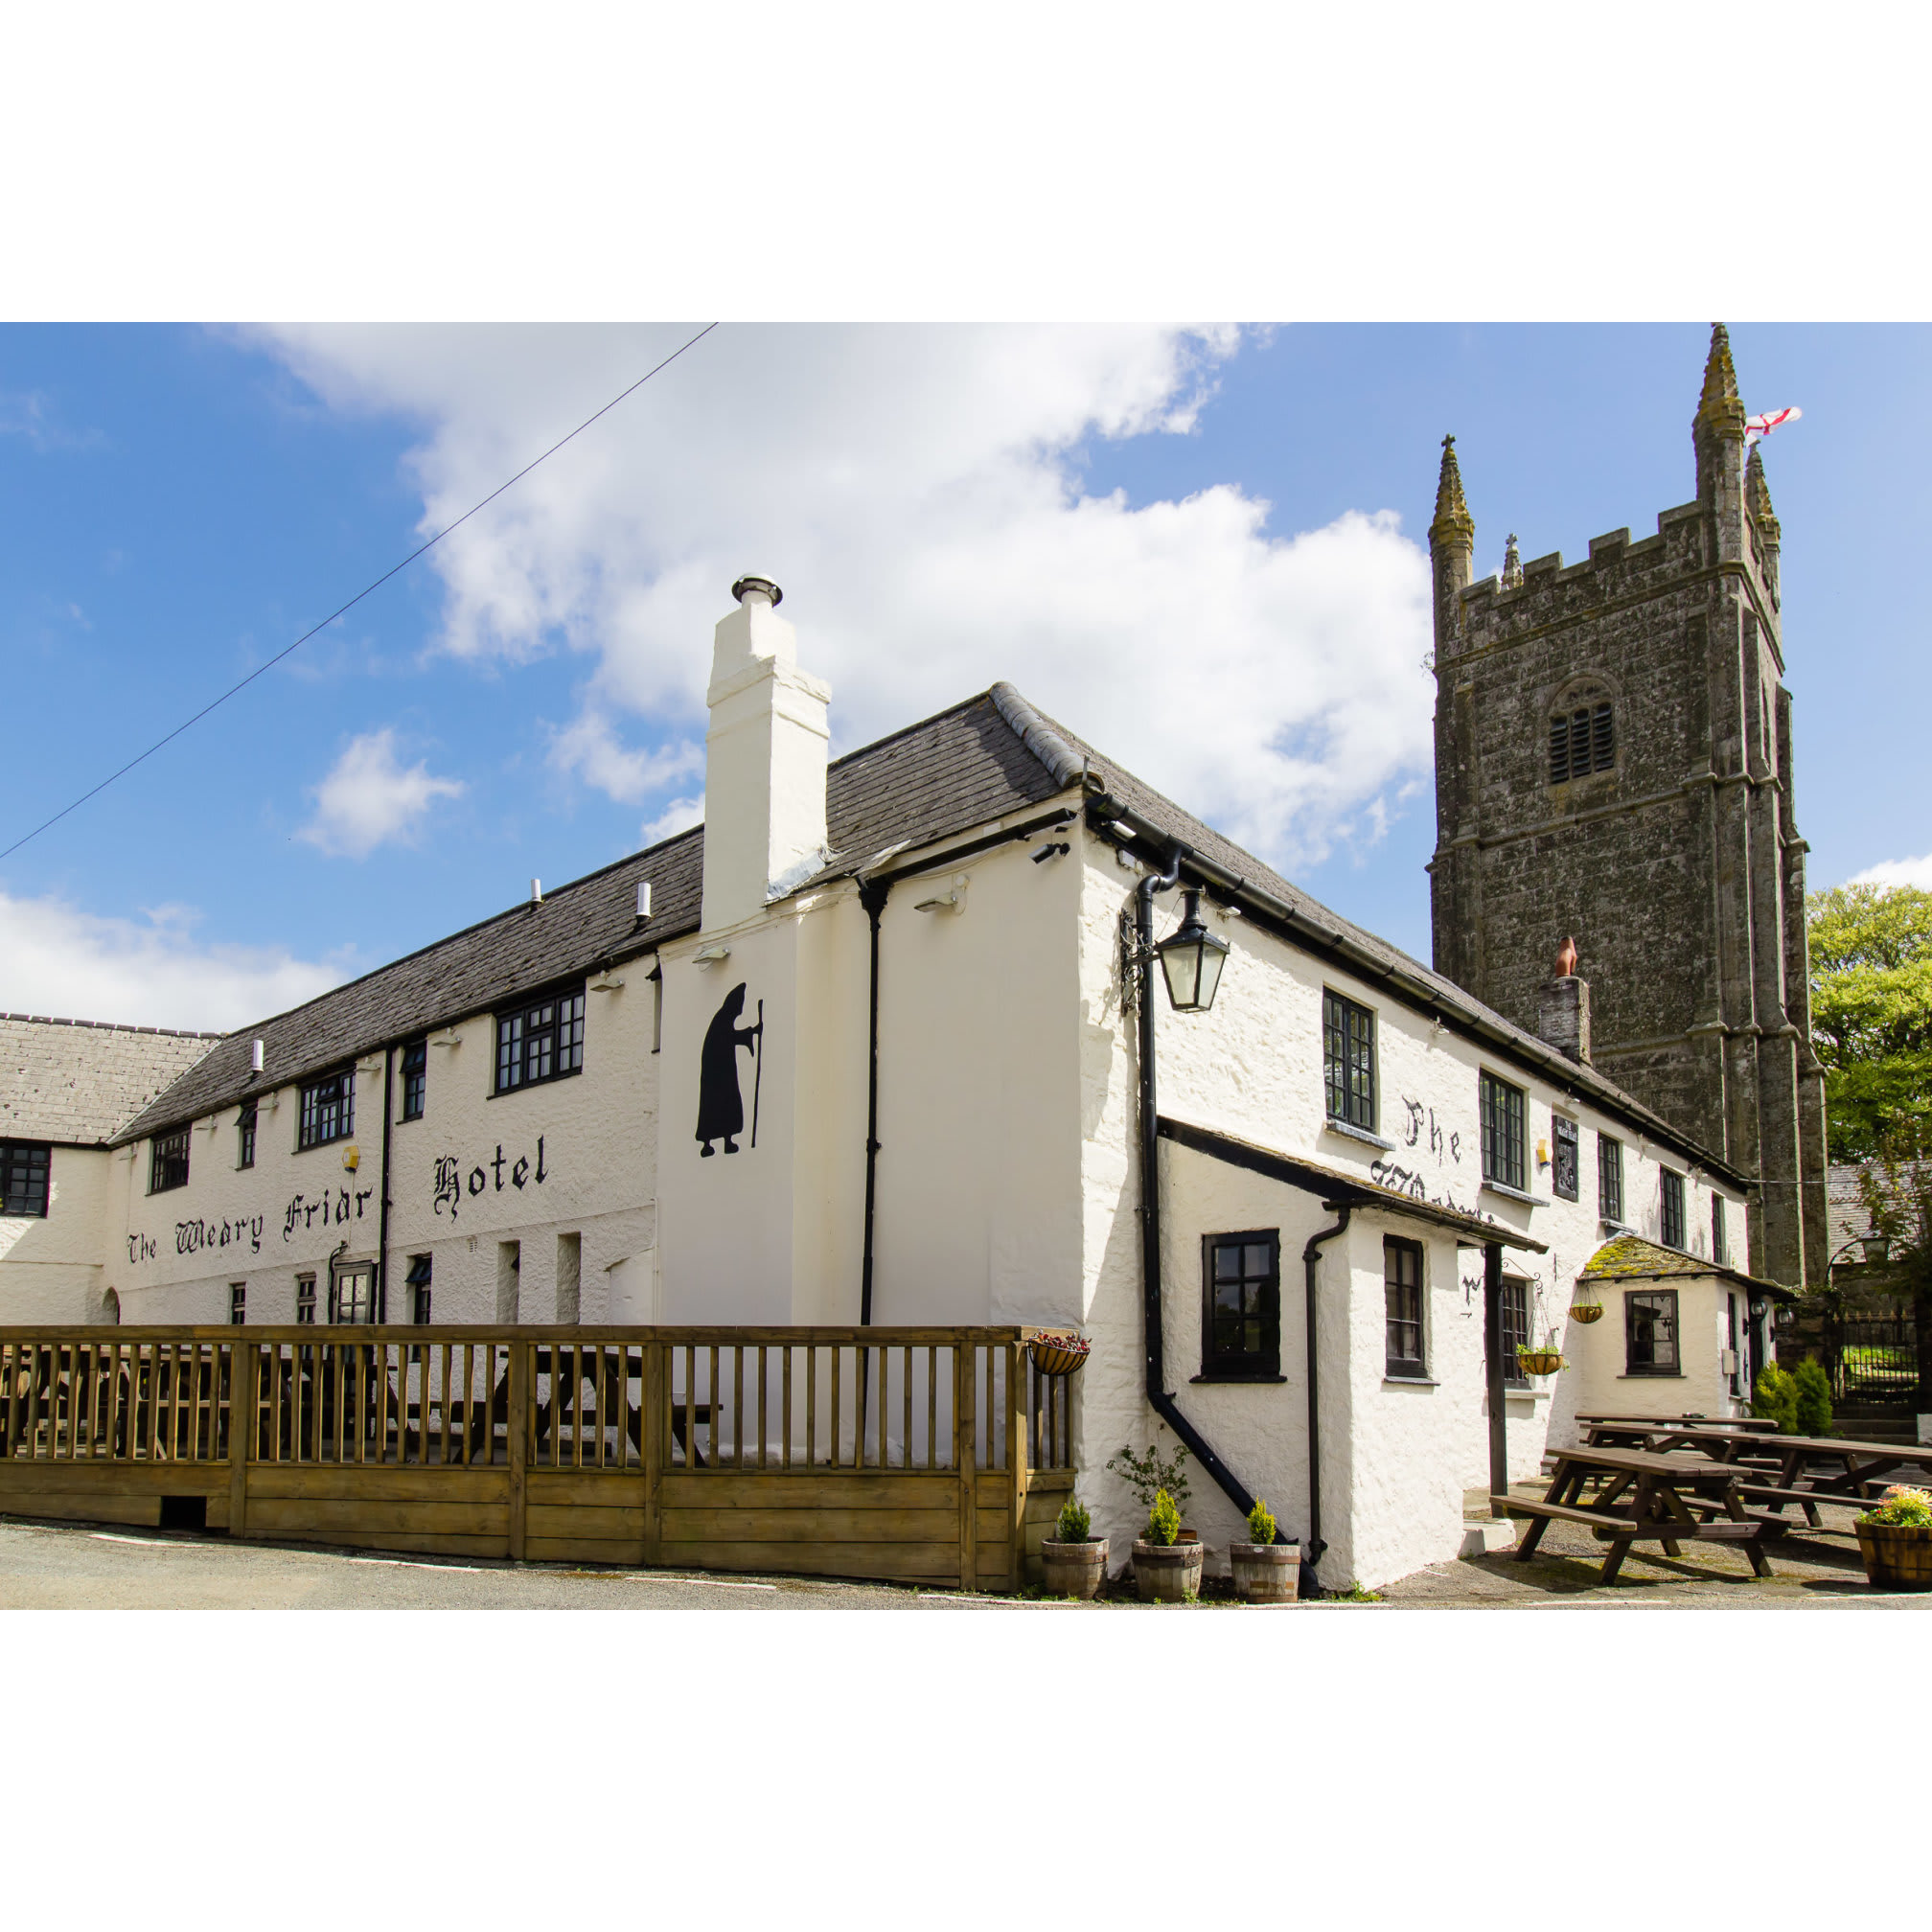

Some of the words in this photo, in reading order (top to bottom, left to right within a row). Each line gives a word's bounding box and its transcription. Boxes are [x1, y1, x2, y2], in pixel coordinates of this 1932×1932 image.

[1401, 1094, 1461, 1167] The
[127, 1233, 156, 1264] The
[175, 1214, 264, 1254] Weary
[283, 1185, 373, 1243] Friar
[433, 1135, 548, 1224] Hotel
